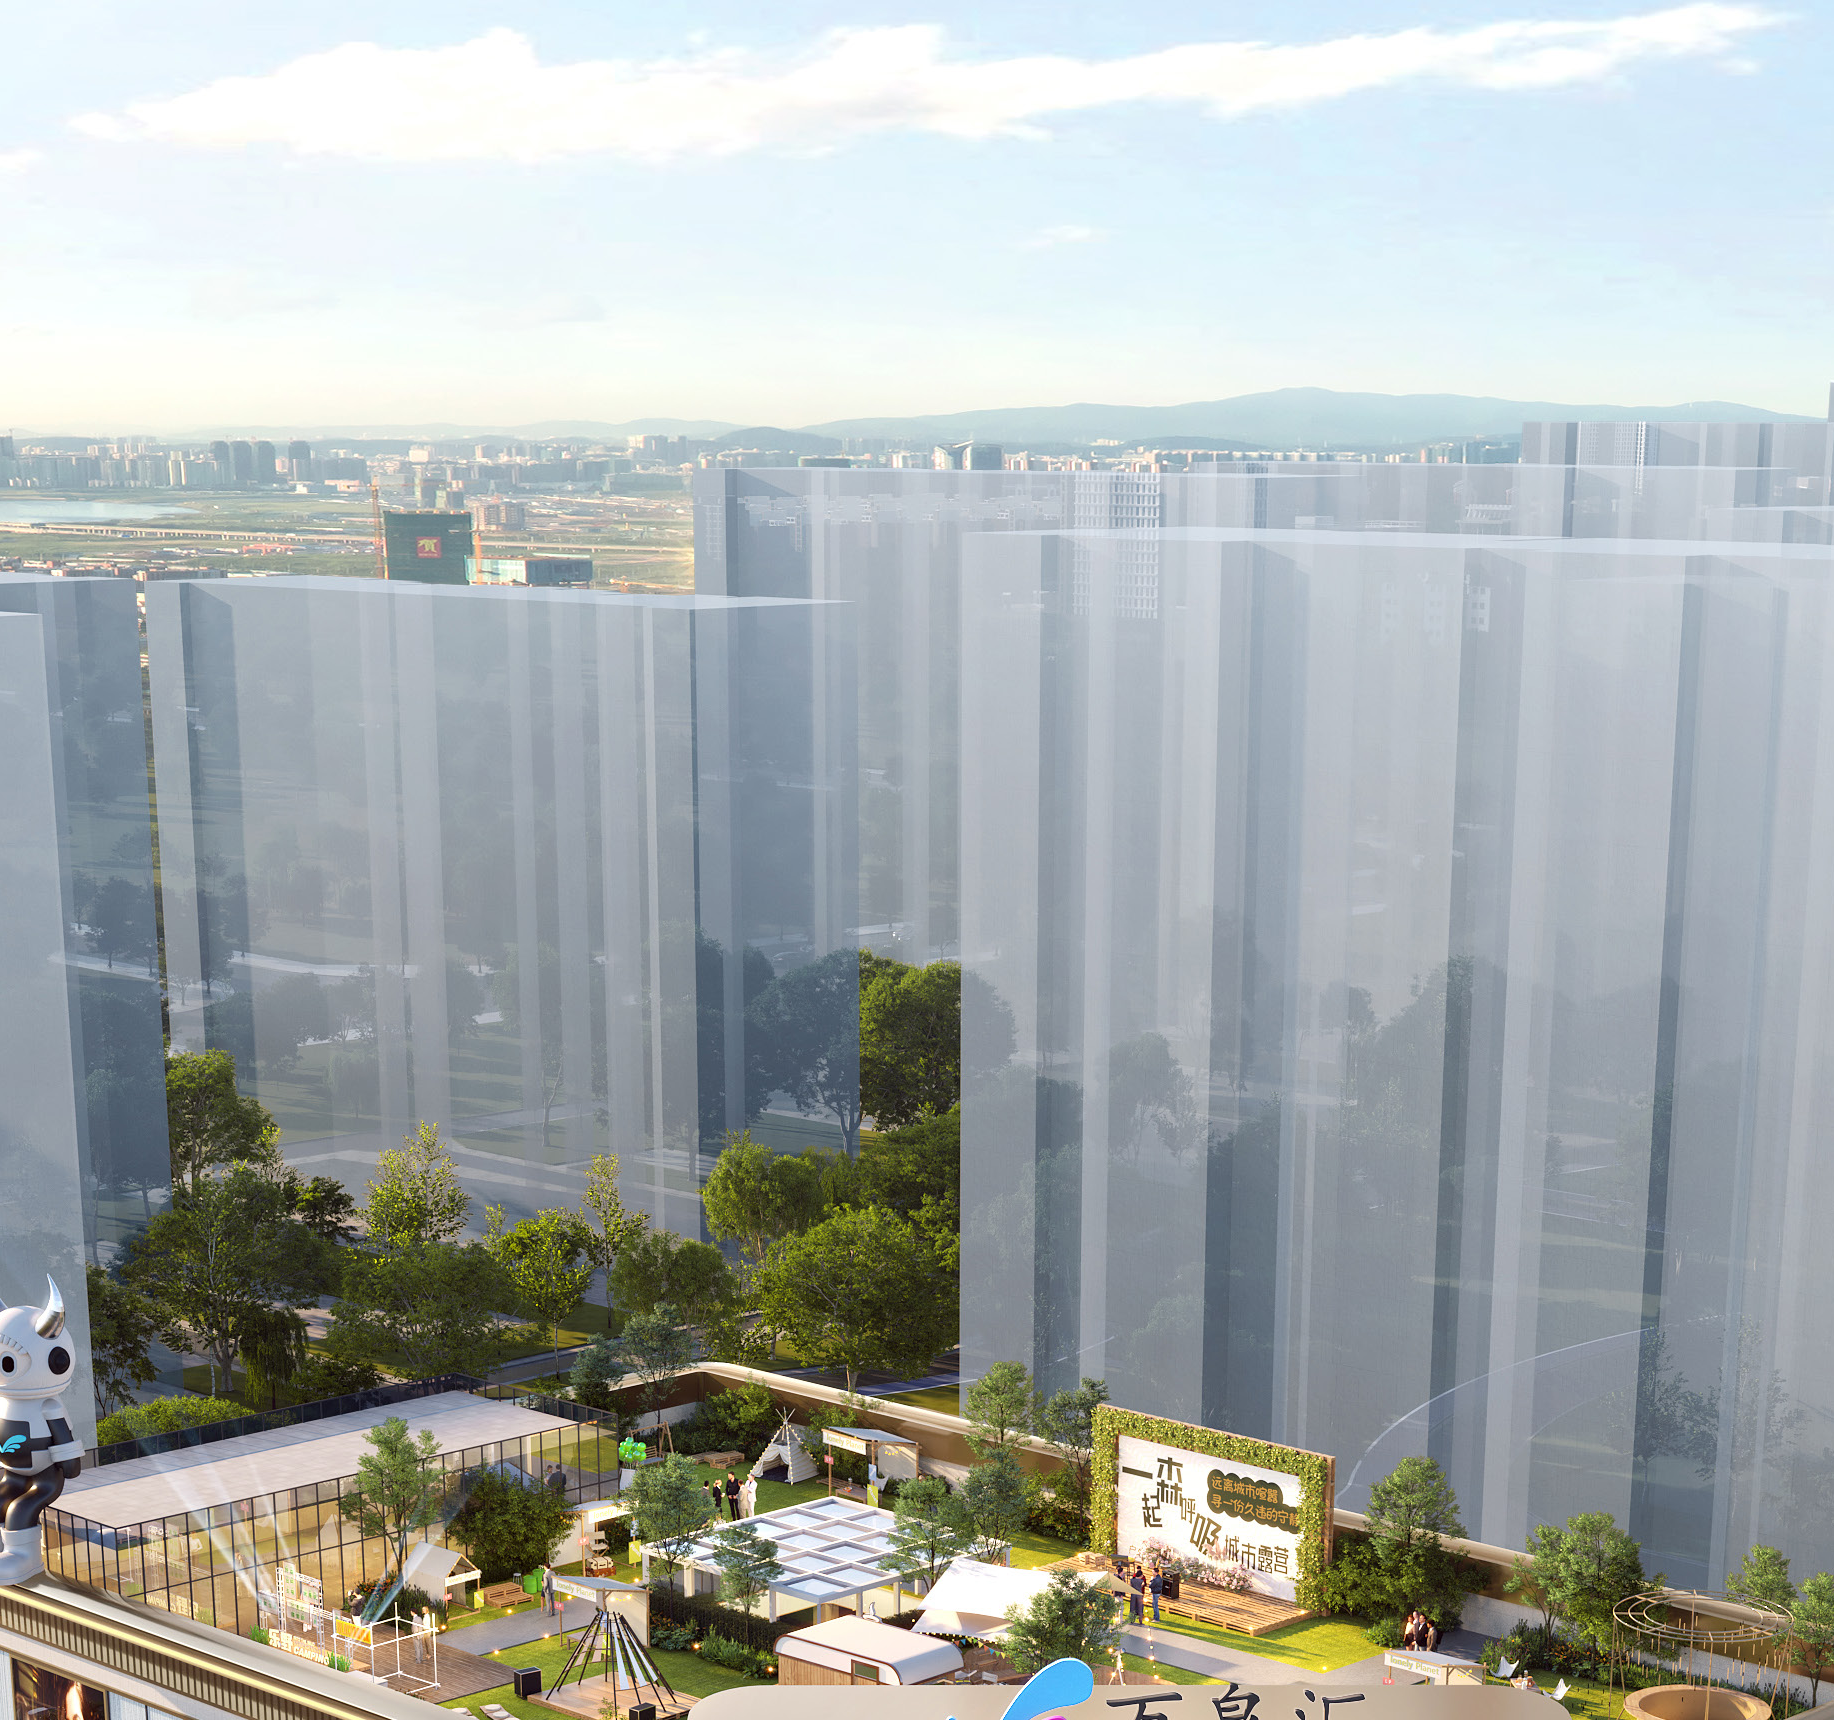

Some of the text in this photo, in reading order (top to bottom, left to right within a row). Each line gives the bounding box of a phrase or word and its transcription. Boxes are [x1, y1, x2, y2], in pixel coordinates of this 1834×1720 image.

[1211, 1476, 1278, 1504] 远离城市喧嚣
[1225, 1535, 1289, 1575] 城市露营
[1415, 1662, 1440, 1676] Planet
